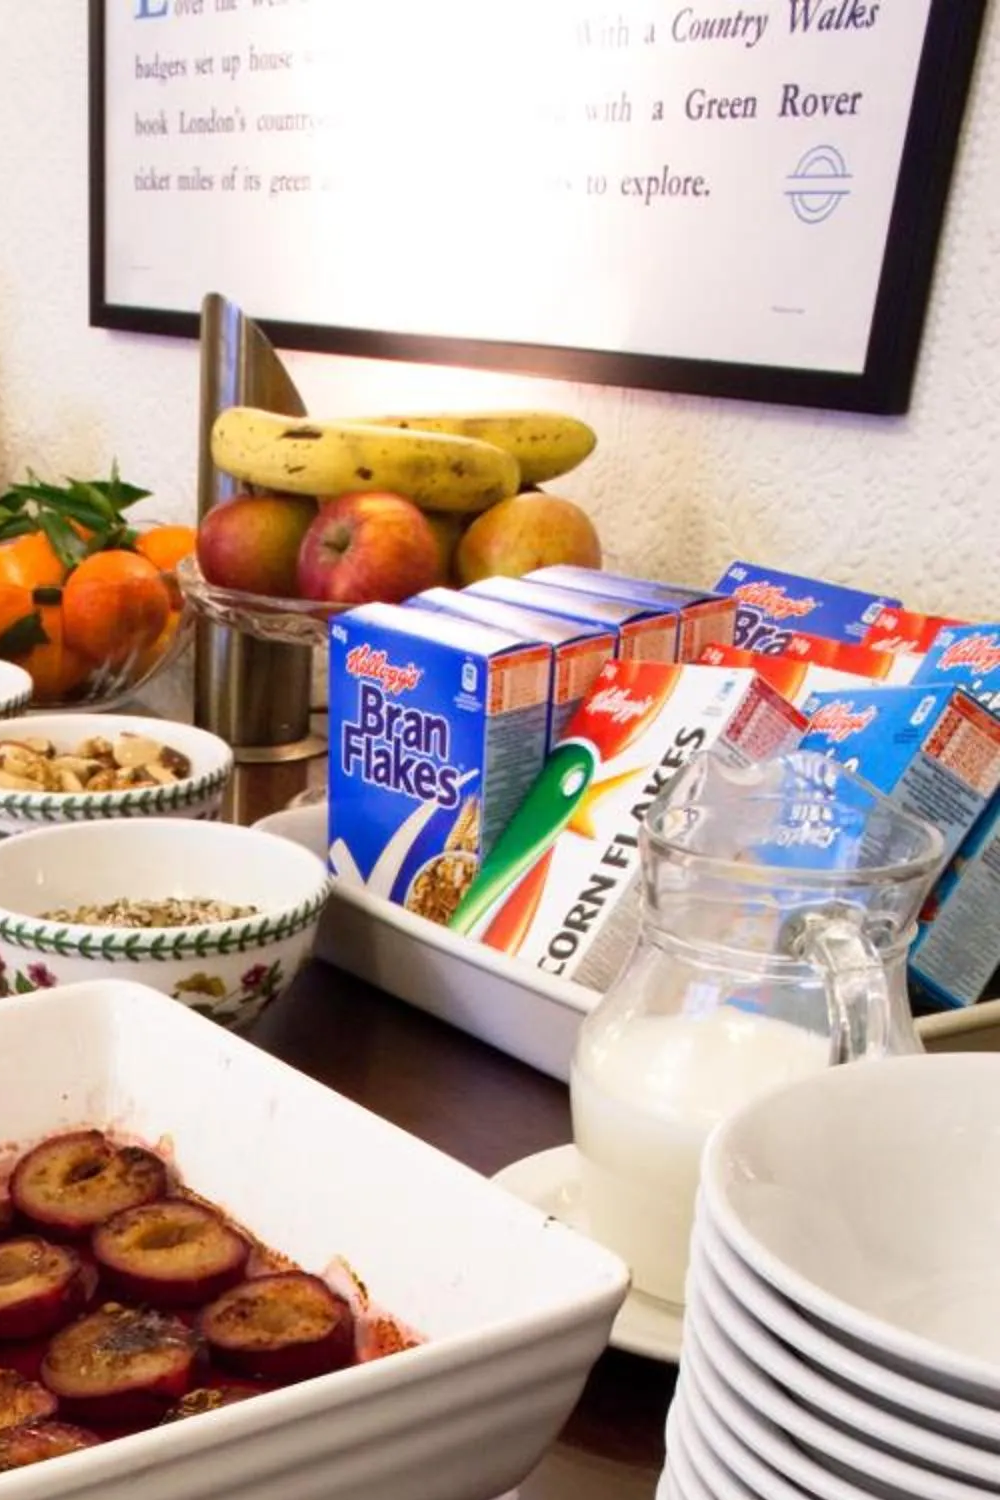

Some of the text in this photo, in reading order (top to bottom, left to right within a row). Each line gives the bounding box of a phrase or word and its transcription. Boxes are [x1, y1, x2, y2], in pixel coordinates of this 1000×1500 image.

[644, 22, 655, 44] a
[671, 8, 769, 48] Country
[788, 0, 879, 33] Walks
[134, 54, 187, 81] badgers
[195, 55, 213, 75] set
[221, 54, 241, 80] up
[248, 45, 293, 71] house
[134, 110, 168, 136] book
[179, 106, 246, 134] London's
[651, 98, 664, 121] a
[685, 88, 757, 121] Green
[778, 84, 862, 119] Rover
[177, 167, 214, 191] miles
[221, 166, 238, 191] of
[244, 167, 261, 191] its
[586, 174, 607, 197] to
[621, 165, 710, 206] explore.
[733, 607, 793, 656] Bra
[359, 681, 449, 762] Bran
[343, 721, 460, 808] Flakes
